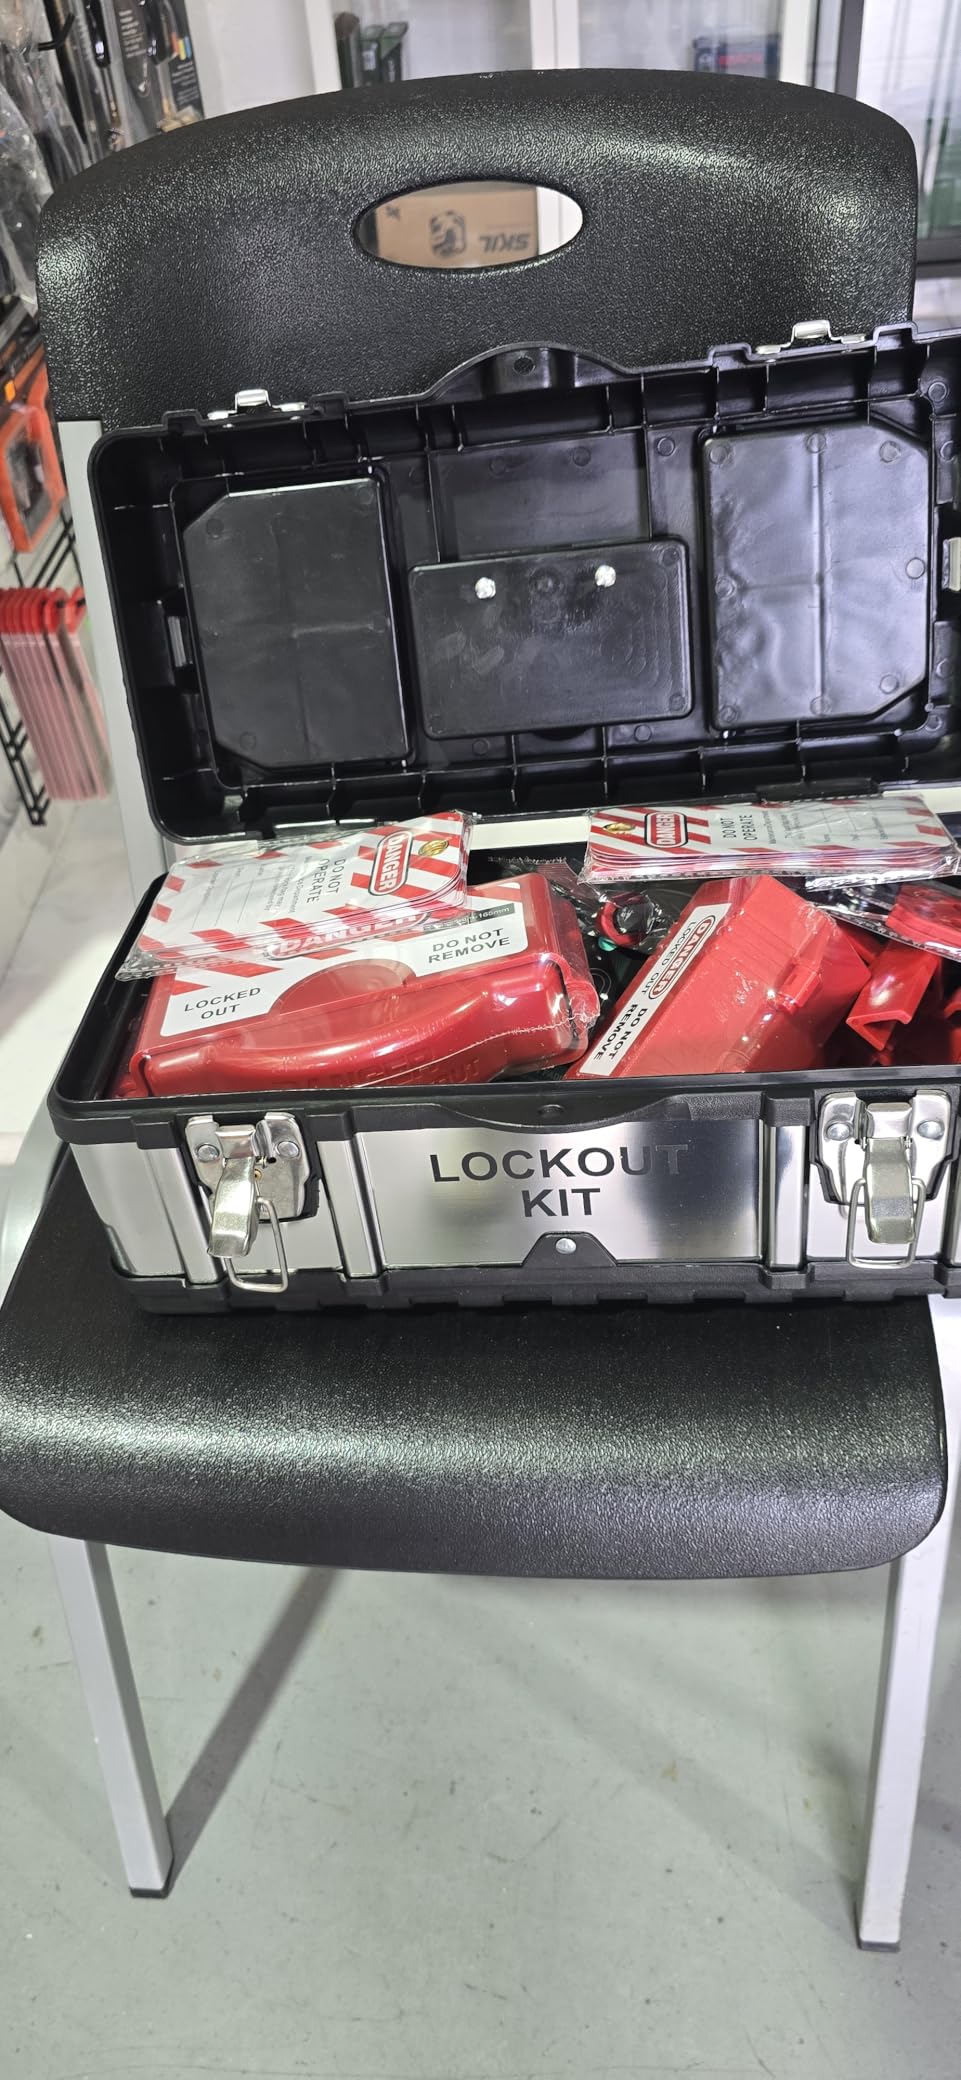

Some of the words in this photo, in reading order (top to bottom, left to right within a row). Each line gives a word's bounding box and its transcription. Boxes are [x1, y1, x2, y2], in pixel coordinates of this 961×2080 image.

[479, 234, 531, 253] SKIL
[656, 812, 676, 845] DANGER
[720, 818, 735, 829] NOT
[721, 830, 737, 839] DO
[739, 814, 758, 841] OPERATE
[332, 859, 346, 873] DO
[378, 834, 405, 891] DANGER
[307, 858, 331, 903] OPERATE
[328, 874, 344, 894] NOT
[428, 937, 511, 964] REMOVE
[432, 939, 460, 952] DO
[464, 928, 504, 944] NOT
[661, 920, 698, 966] LOCKED
[652, 919, 711, 993] DANGER
[641, 972, 659, 995] OUT
[184, 987, 261, 1012] LOCKED
[200, 1003, 241, 1020] OUT
[593, 1003, 639, 1060] REMOVE
[630, 1008, 648, 1028] DO
[608, 1030, 632, 1060] NOT
[430, 1144, 688, 1182] LOCKOUT
[521, 1187, 600, 1217] KIT
